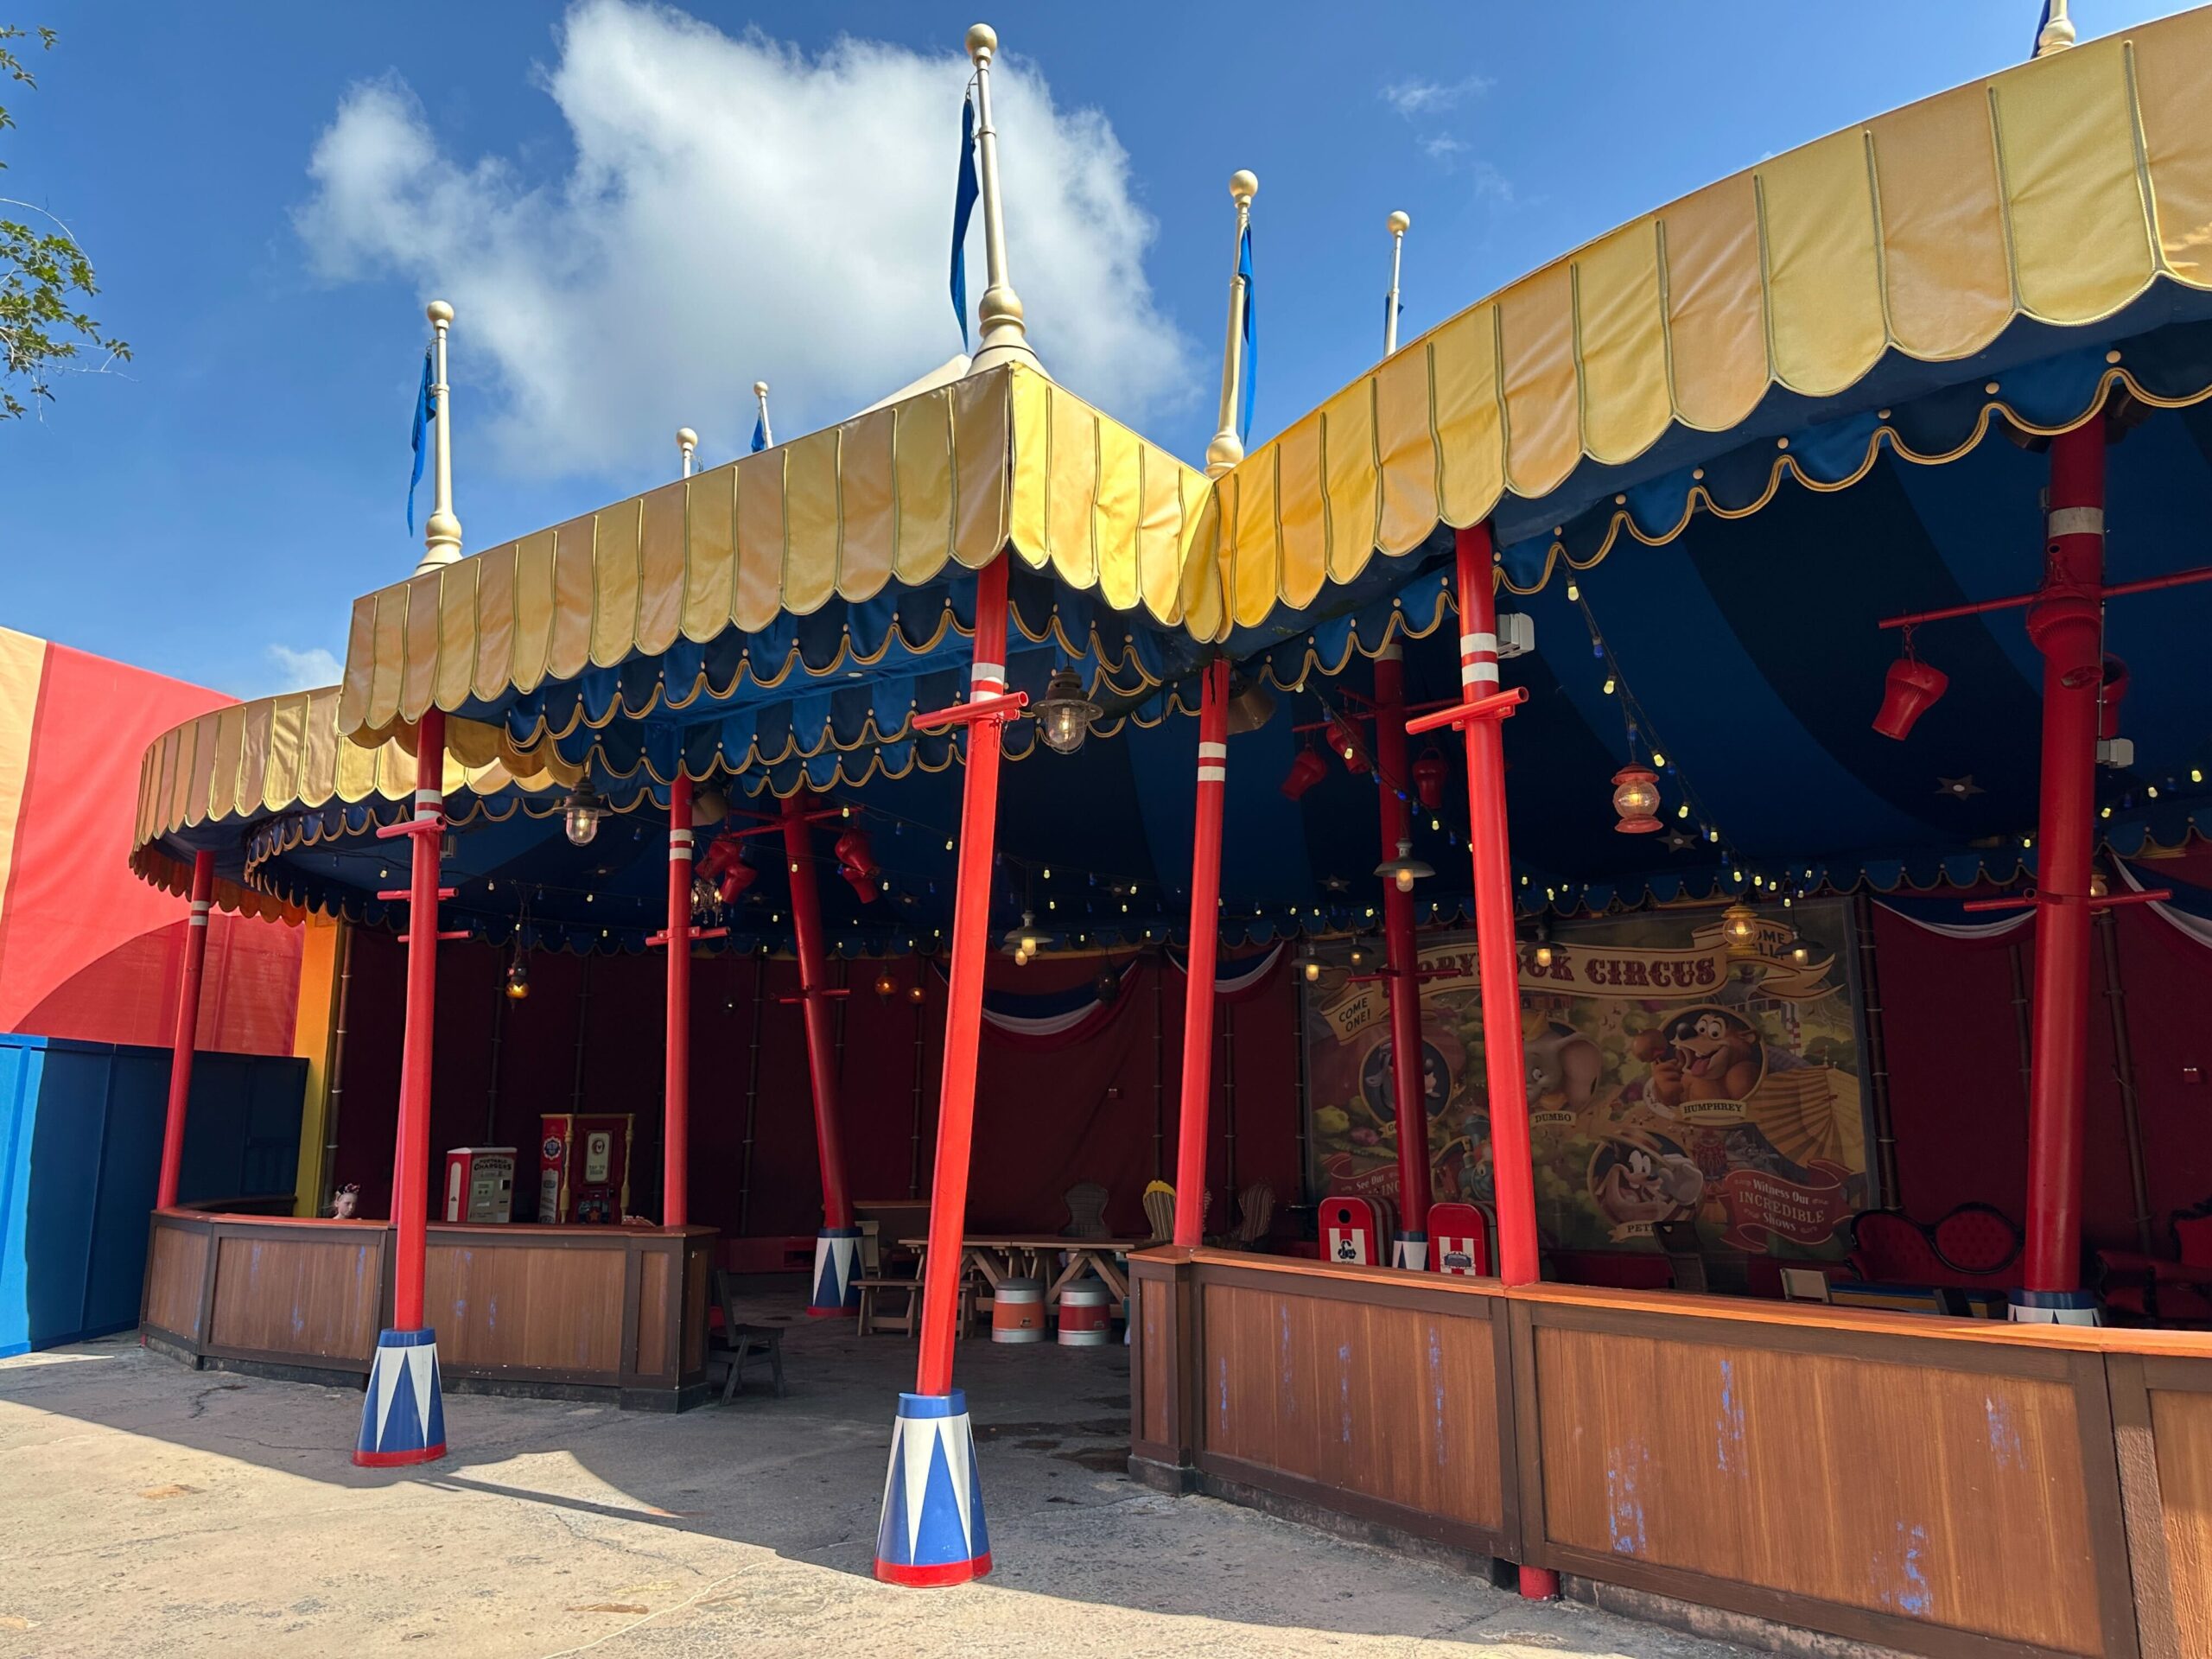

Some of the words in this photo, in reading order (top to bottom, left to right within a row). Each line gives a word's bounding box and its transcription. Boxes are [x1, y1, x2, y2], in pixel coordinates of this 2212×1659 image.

[1585, 957, 1715, 987] CIRCUS
[1338, 997, 1368, 1022] COME
[1345, 1009, 1370, 1032] ONE!
[1535, 1112, 1572, 1123] DUMBO
[1683, 1103, 1743, 1114] HUMPHREY
[1356, 1180, 1370, 1190] See
[1371, 1174, 1384, 1185] Our
[1752, 1179, 1790, 1199] Witness
[1792, 1191, 1809, 1205] Our
[1738, 1191, 1825, 1224] INCREDIBLE
[1763, 1211, 1796, 1231] Shows
